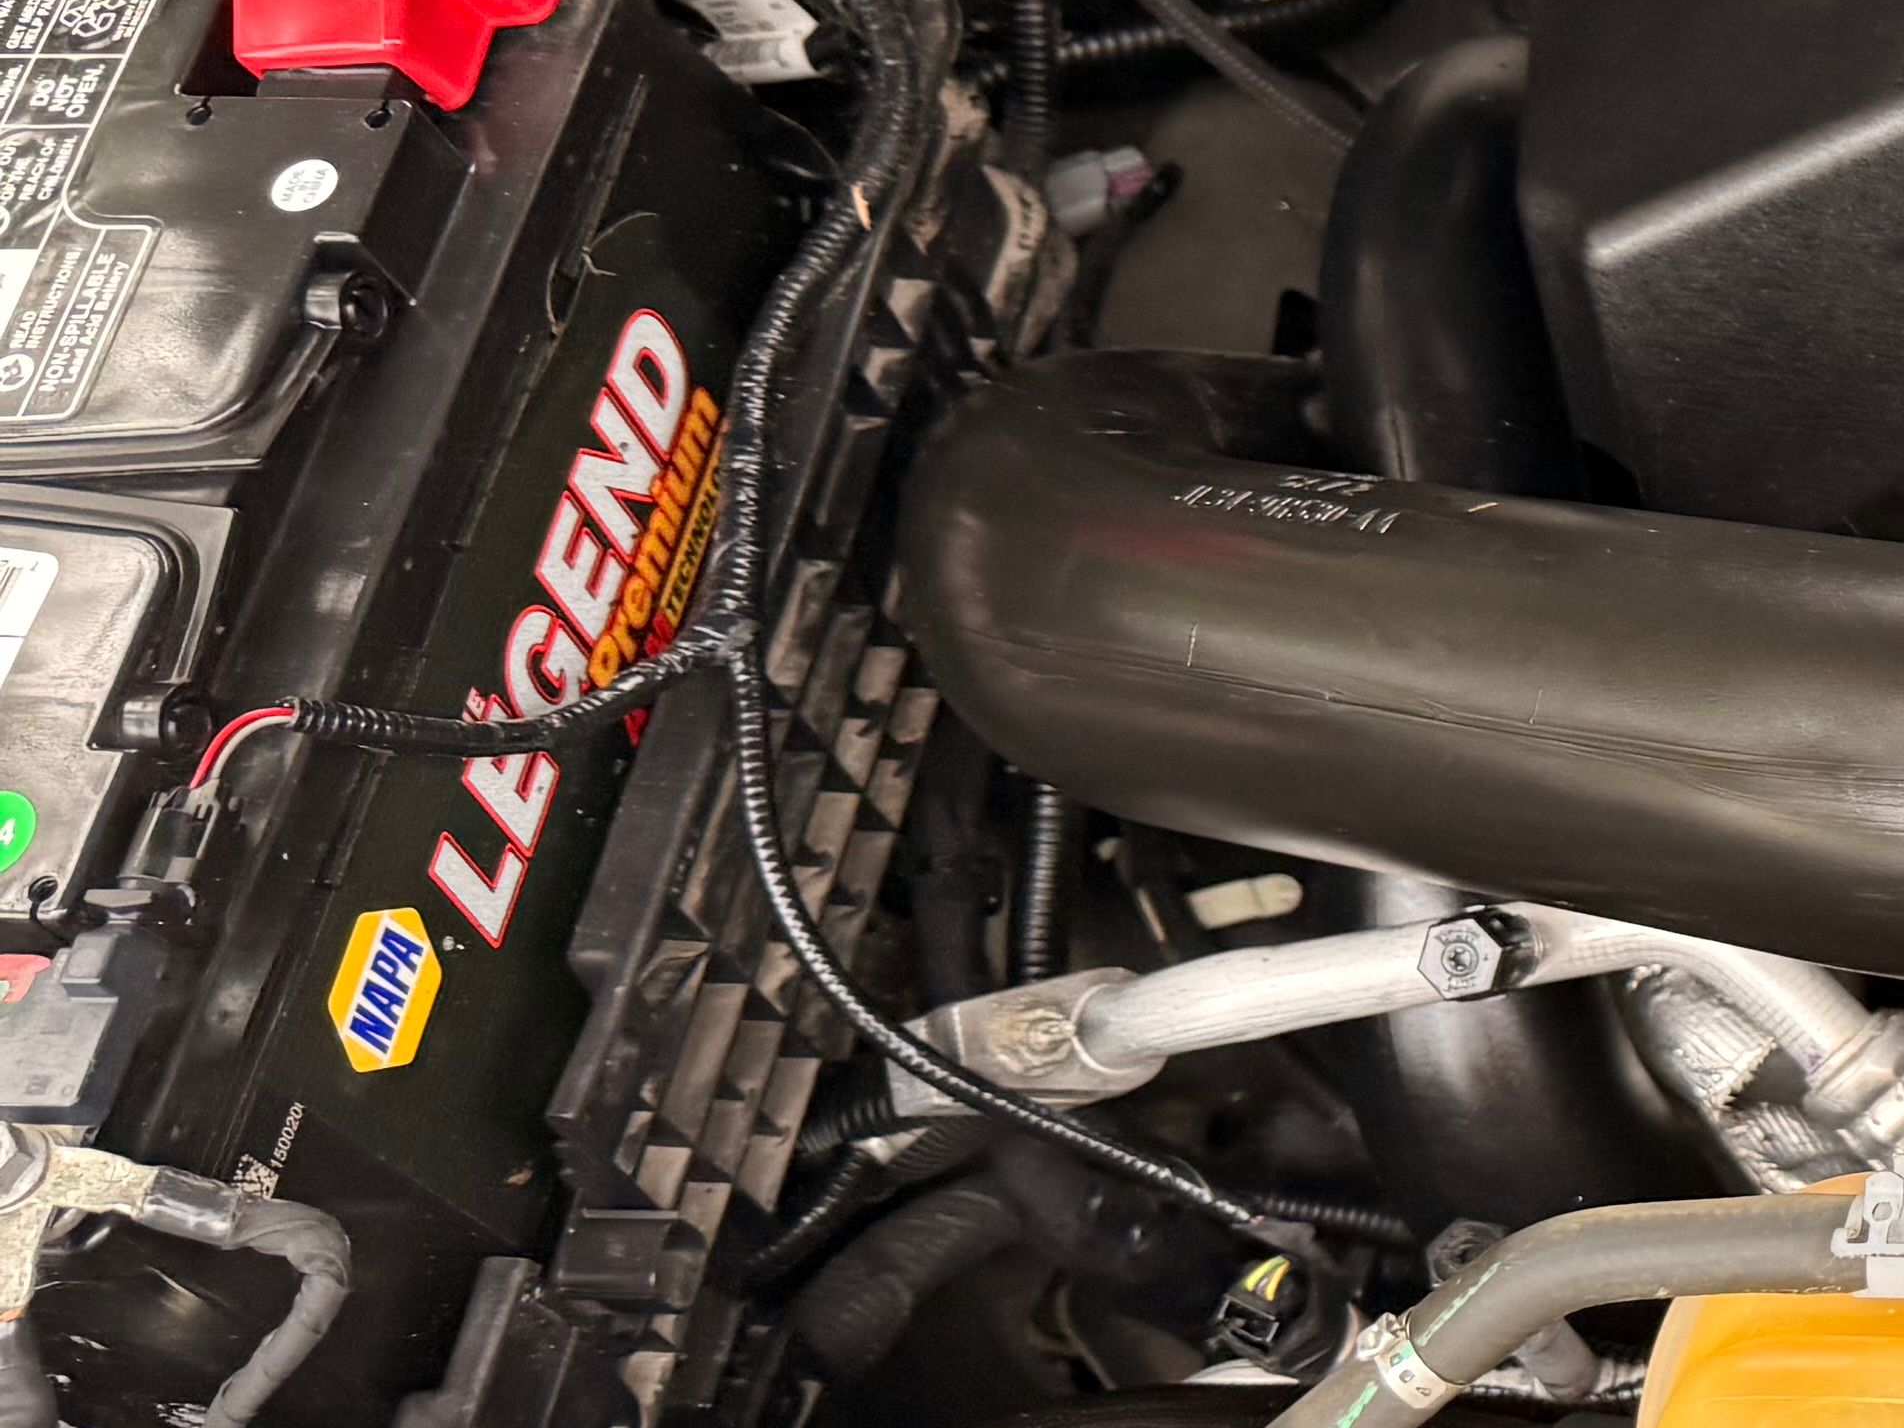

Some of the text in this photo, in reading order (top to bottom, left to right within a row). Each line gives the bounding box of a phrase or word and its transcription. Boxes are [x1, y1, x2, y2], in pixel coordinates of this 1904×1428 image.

[29, 79, 57, 108] DO
[48, 74, 79, 112] NOT
[65, 63, 107, 118] OPEN.
[9, 310, 38, 349] READ
[39, 252, 117, 392] NON-SPILLABLE
[61, 261, 131, 384] Lead Acid Battery
[348, 926, 426, 1056] NAPA
